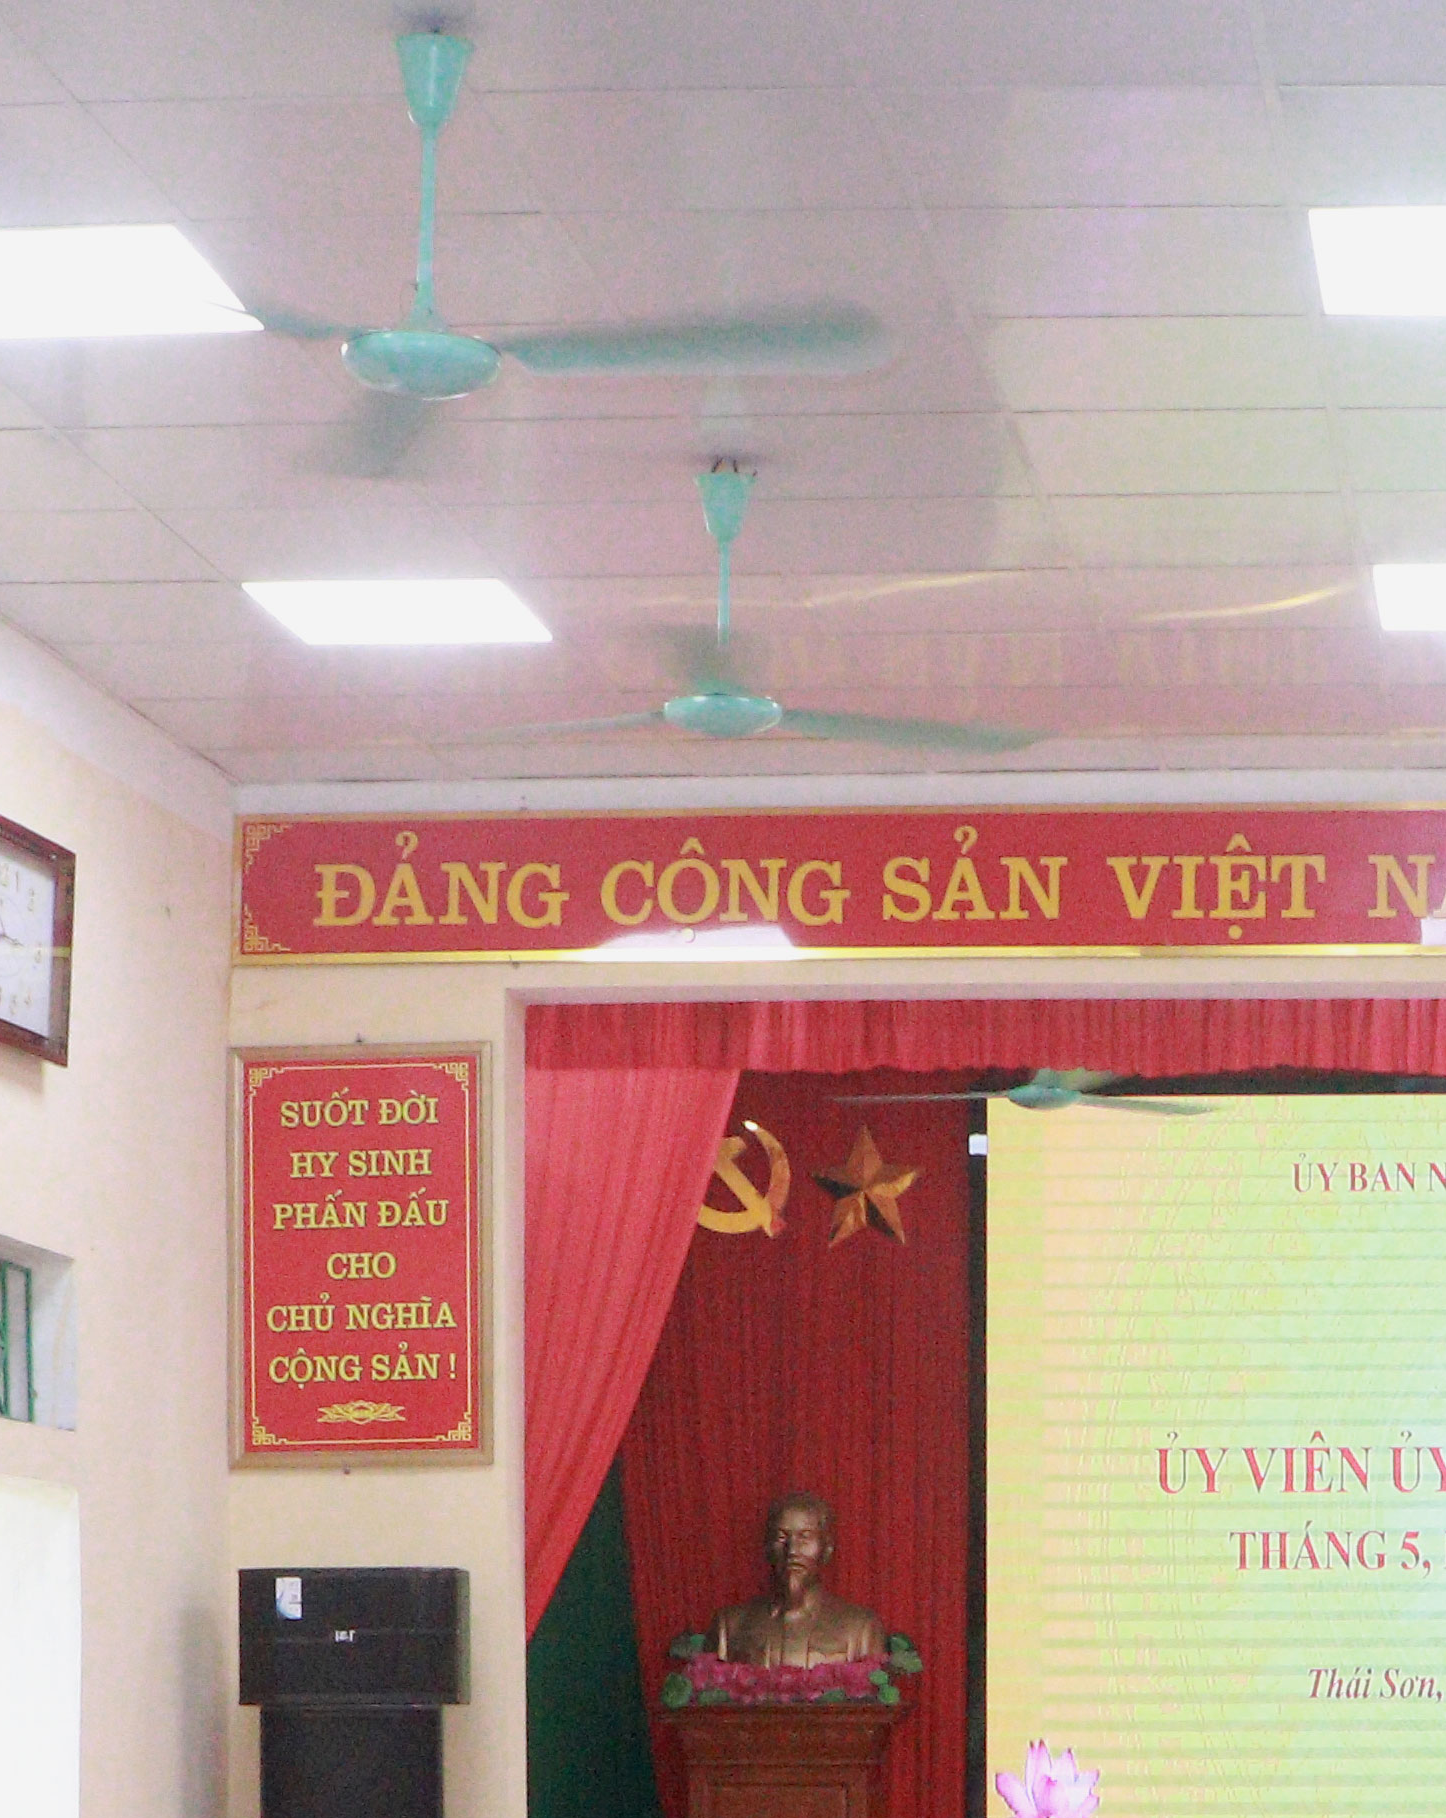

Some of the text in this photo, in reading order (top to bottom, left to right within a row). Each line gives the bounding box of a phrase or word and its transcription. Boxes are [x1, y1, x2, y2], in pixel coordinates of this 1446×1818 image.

[313, 831, 570, 928] ĐẢNG
[600, 837, 850, 943] CỘNG
[882, 826, 1066, 921] SẢN
[1107, 834, 1325, 940] VIỆT
[280, 1087, 439, 1128] SUỐT ĐỜI
[290, 1149, 432, 1178] HY SINH
[1293, 1153, 1338, 1192] ỦY
[1349, 1162, 1416, 1192] BAN
[273, 1187, 449, 1230] PHẤN ĐẤU
[327, 1252, 396, 1280] CHO
[266, 1292, 457, 1333] CHỦ NGHĨA
[269, 1342, 457, 1389] CỘNG SẢN !
[1155, 1431, 1229, 1493] ỦY
[1242, 1430, 1373, 1493] VIÊN
[1229, 1521, 1386, 1571] THÁNG
[1400, 1531, 1431, 1573] 5,
[1307, 1667, 1373, 1699] Thái
[1379, 1667, 1442, 1702] Sơn,
